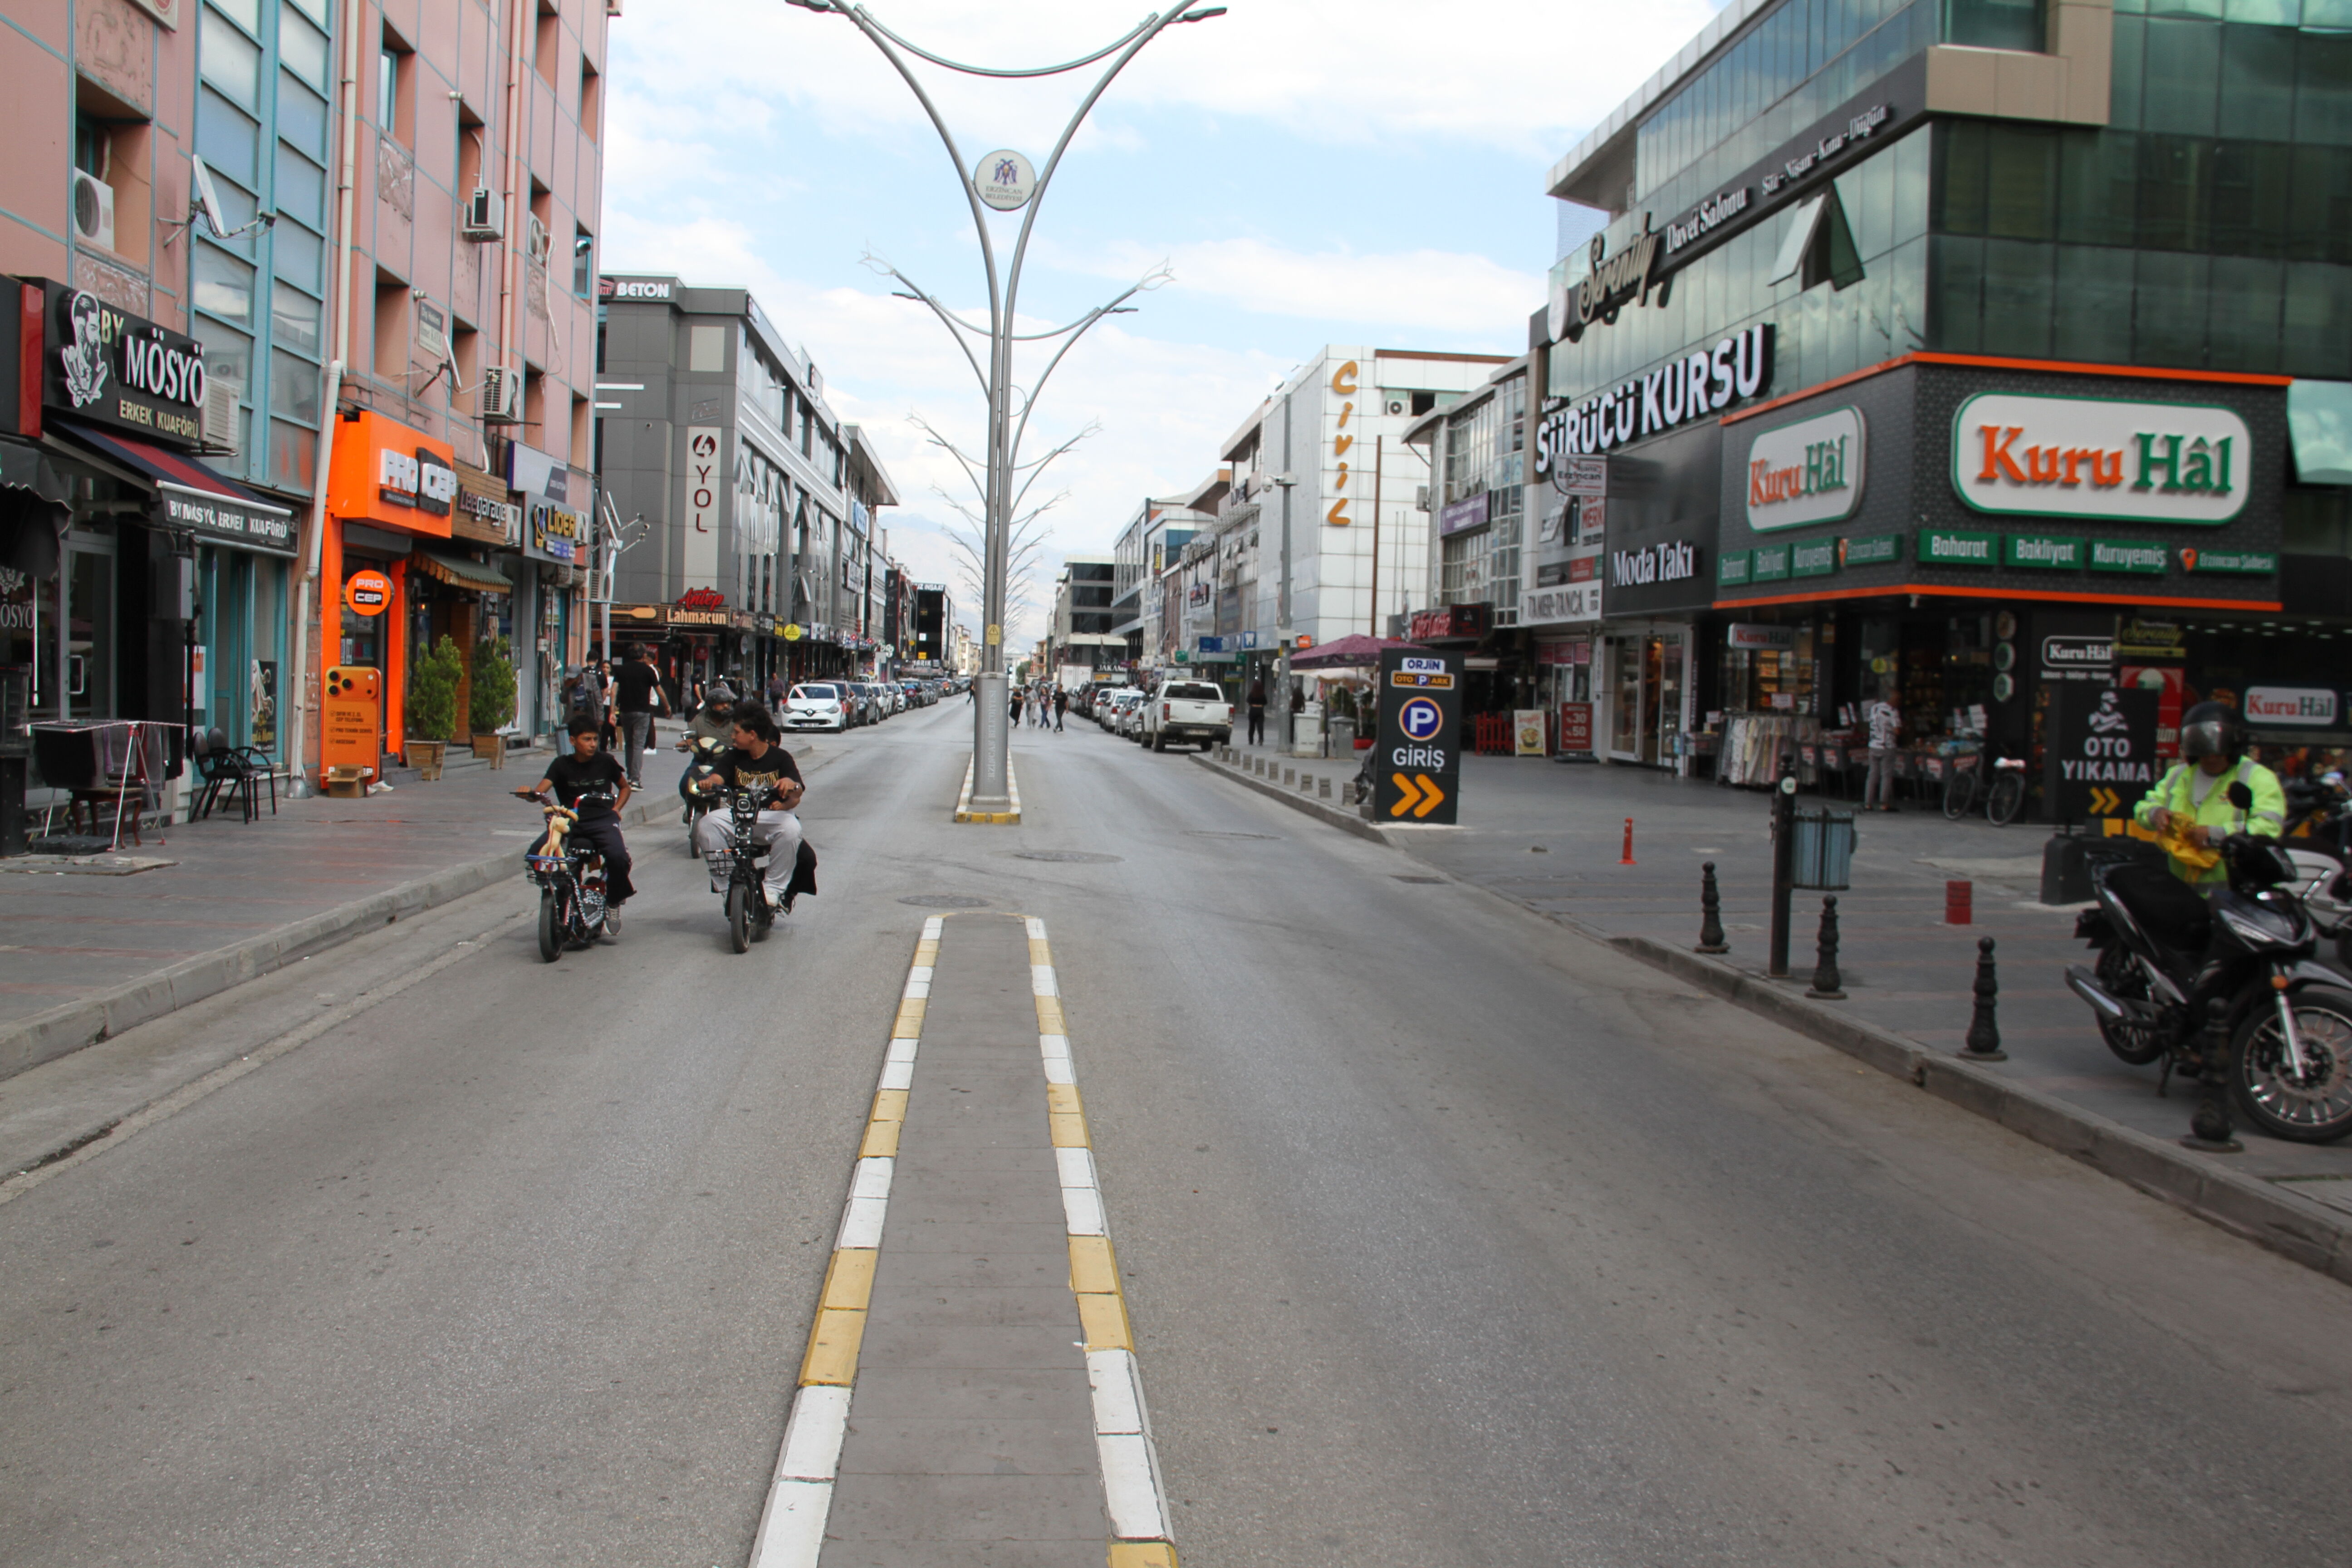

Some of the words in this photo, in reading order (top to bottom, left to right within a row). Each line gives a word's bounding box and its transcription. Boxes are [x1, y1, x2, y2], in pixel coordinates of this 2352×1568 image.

[1785, 154, 1813, 179] Nişan
[1818, 134, 1844, 160] Kına
[1850, 105, 1887, 140] Düğün
[1666, 207, 1700, 254] Davet
[1700, 187, 1747, 233] Salonu
[617, 281, 669, 298] BETON
[101, 309, 124, 348] BY
[126, 327, 206, 408] MÖSYÖ
[1535, 381, 1636, 474] SÜRÜCÜ
[1641, 323, 1764, 434] KURSU
[119, 399, 153, 424] ERKEK
[157, 410, 199, 439] KUAFÖRÜ
[380, 448, 418, 494] PRO
[1749, 459, 1801, 507] Kuru
[1805, 433, 1850, 494] Hâl
[1976, 425, 2124, 485] Kuru
[2133, 432, 2234, 493] Hâl
[421, 462, 457, 504] CEP
[168, 500, 182, 518] BY
[1931, 535, 1988, 558] Baharat
[2016, 539, 2076, 565] Bakliyat
[2093, 543, 2167, 569] Kuruyemiş
[1612, 547, 1655, 587] Moda
[1655, 540, 1695, 581] Takı
[356, 579, 384, 588] PRO
[355, 593, 382, 603] CEP
[676, 586, 725, 612] Antep
[666, 608, 726, 625] Lahmacun
[2049, 644, 2086, 659] Kuru
[1419, 676, 1428, 685] P
[2247, 695, 2297, 715] Kuru
[1409, 707, 1435, 733] P
[1392, 744, 1445, 773] GİRİŞ
[2084, 736, 2131, 757] OTO
[2061, 760, 2151, 782] YIKAMA
